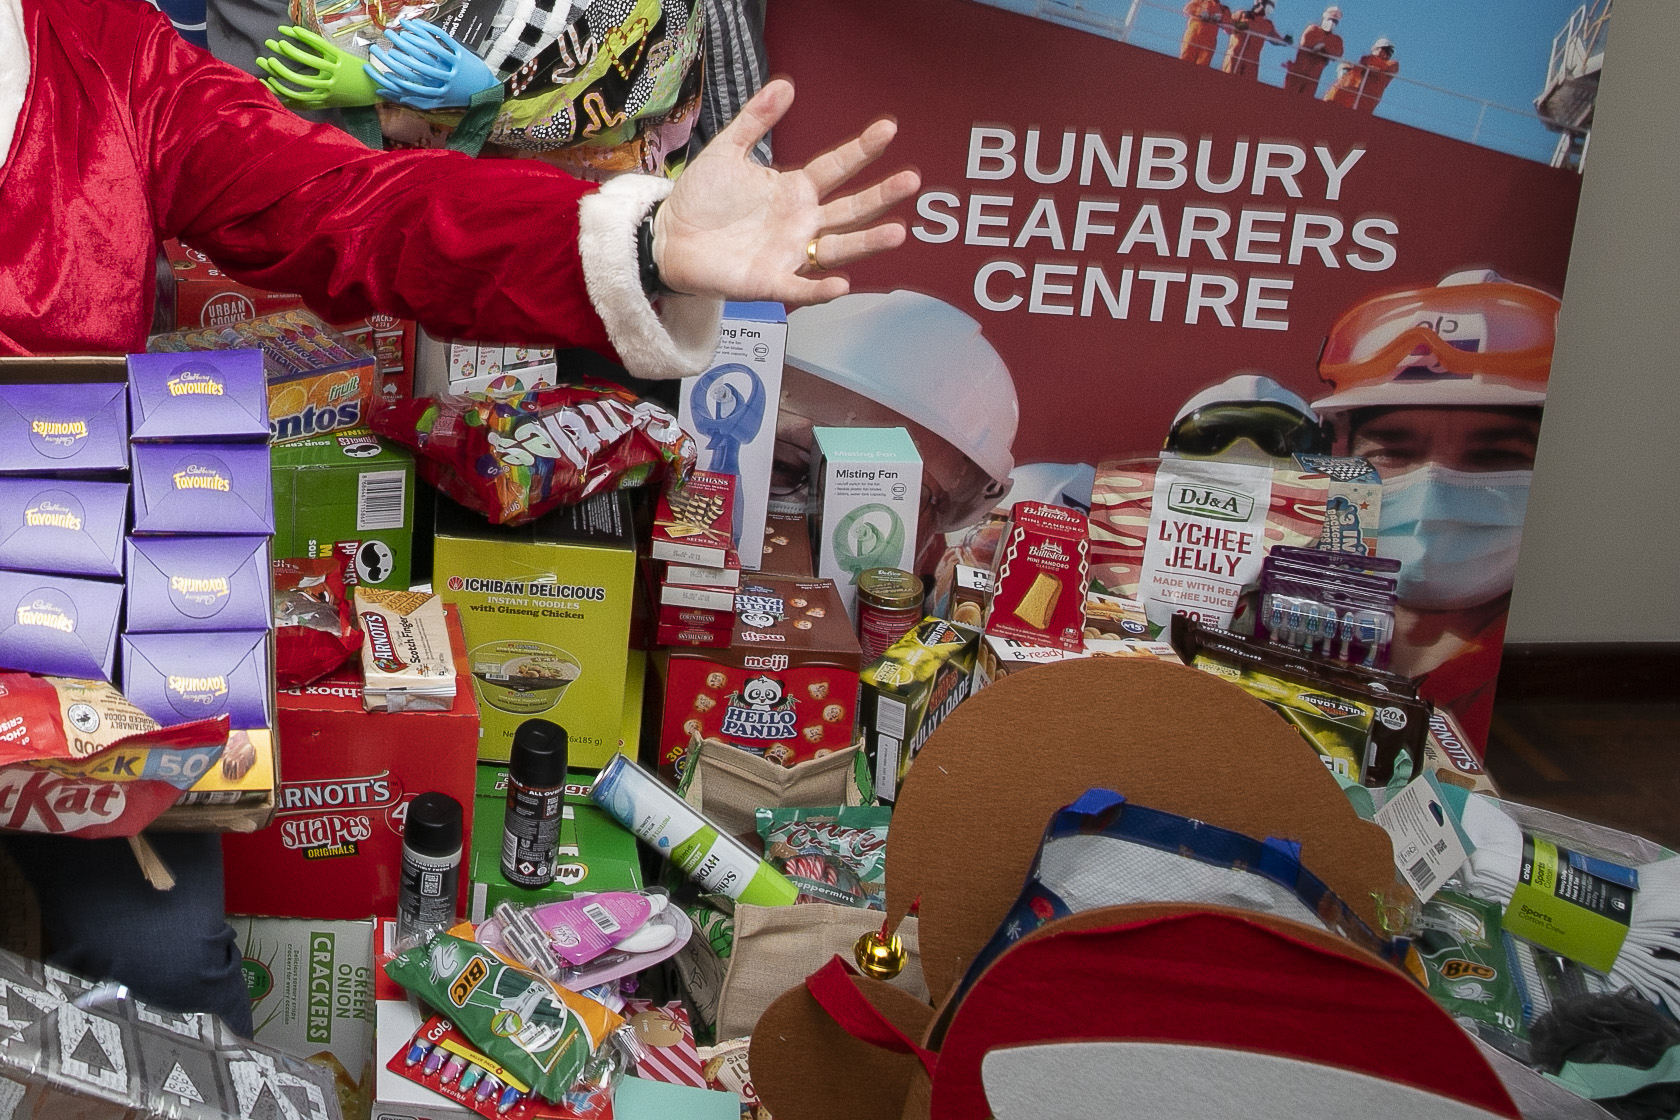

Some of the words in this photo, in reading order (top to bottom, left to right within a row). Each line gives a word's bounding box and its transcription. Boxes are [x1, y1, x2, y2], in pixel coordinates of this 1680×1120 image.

[966, 124, 1366, 201] BUNBURY
[911, 191, 1399, 273] SEAFARERS
[973, 260, 1294, 332] CENTRE
[208, 300, 246, 318] URBAN
[740, 328, 761, 339] Fan
[181, 371, 211, 381] Cadbury
[167, 378, 224, 396] Favourites
[328, 375, 359, 401] fruit
[32, 418, 88, 440] Favourites
[269, 400, 362, 443] entos
[187, 465, 216, 476] Cadbury
[836, 470, 876, 480] Misting
[878, 470, 898, 479] Fan
[173, 472, 230, 492] Favourites
[40, 501, 69, 513] Cadbury
[1178, 488, 1240, 514] DJ&A
[25, 508, 81, 530] Favourites
[1021, 516, 1040, 525] MINI
[1043, 520, 1085, 533] PANDORO
[1340, 513, 1355, 526] 3
[1159, 520, 1254, 555] LYCHEE
[1342, 530, 1358, 553] IN
[1027, 556, 1041, 564] MINI
[1042, 558, 1070, 569] PANDORO
[1165, 546, 1242, 577] JELLY
[171, 576, 230, 598] Favourites
[464, 578, 525, 595] ICHIBAN
[529, 583, 606, 601] DELICIOUS
[1153, 576, 1184, 589] MADE
[1186, 581, 1215, 593] WITH
[32, 600, 63, 614] Cadbury
[487, 596, 530, 606] INSTANT
[532, 599, 580, 610] NOODLES
[1161, 589, 1200, 602] LYCHEE
[1203, 595, 1234, 608] JUICE
[17, 605, 73, 632] Favourites
[470, 604, 496, 613] with
[497, 606, 539, 618] Ginseng
[541, 609, 585, 620] Chicken
[399, 615, 414, 638] Finger
[366, 614, 394, 660] ARNOTT'S
[402, 637, 421, 664] Scotch
[1013, 648, 1065, 660] B-ready
[744, 654, 789, 671] meiji
[168, 675, 228, 697] Favourites
[727, 706, 798, 725] HELLO
[909, 710, 940, 758] FULLY
[940, 674, 971, 723] LOADE
[1383, 709, 1397, 720] 20
[721, 720, 798, 739] PANDA
[666, 746, 684, 762] 30
[157, 753, 210, 779] 50
[279, 780, 390, 809] RNOTT'S
[308, 845, 355, 858] ORIGINALS
[1535, 862, 1546, 886] Sports
[1518, 912, 1545, 927] Cotton
[1521, 904, 1553, 923] Sports
[309, 937, 332, 1038] CRACKERS
[336, 964, 352, 1019] ONION
[353, 967, 370, 1020] GREEN
[1496, 1011, 1515, 1029] 10
